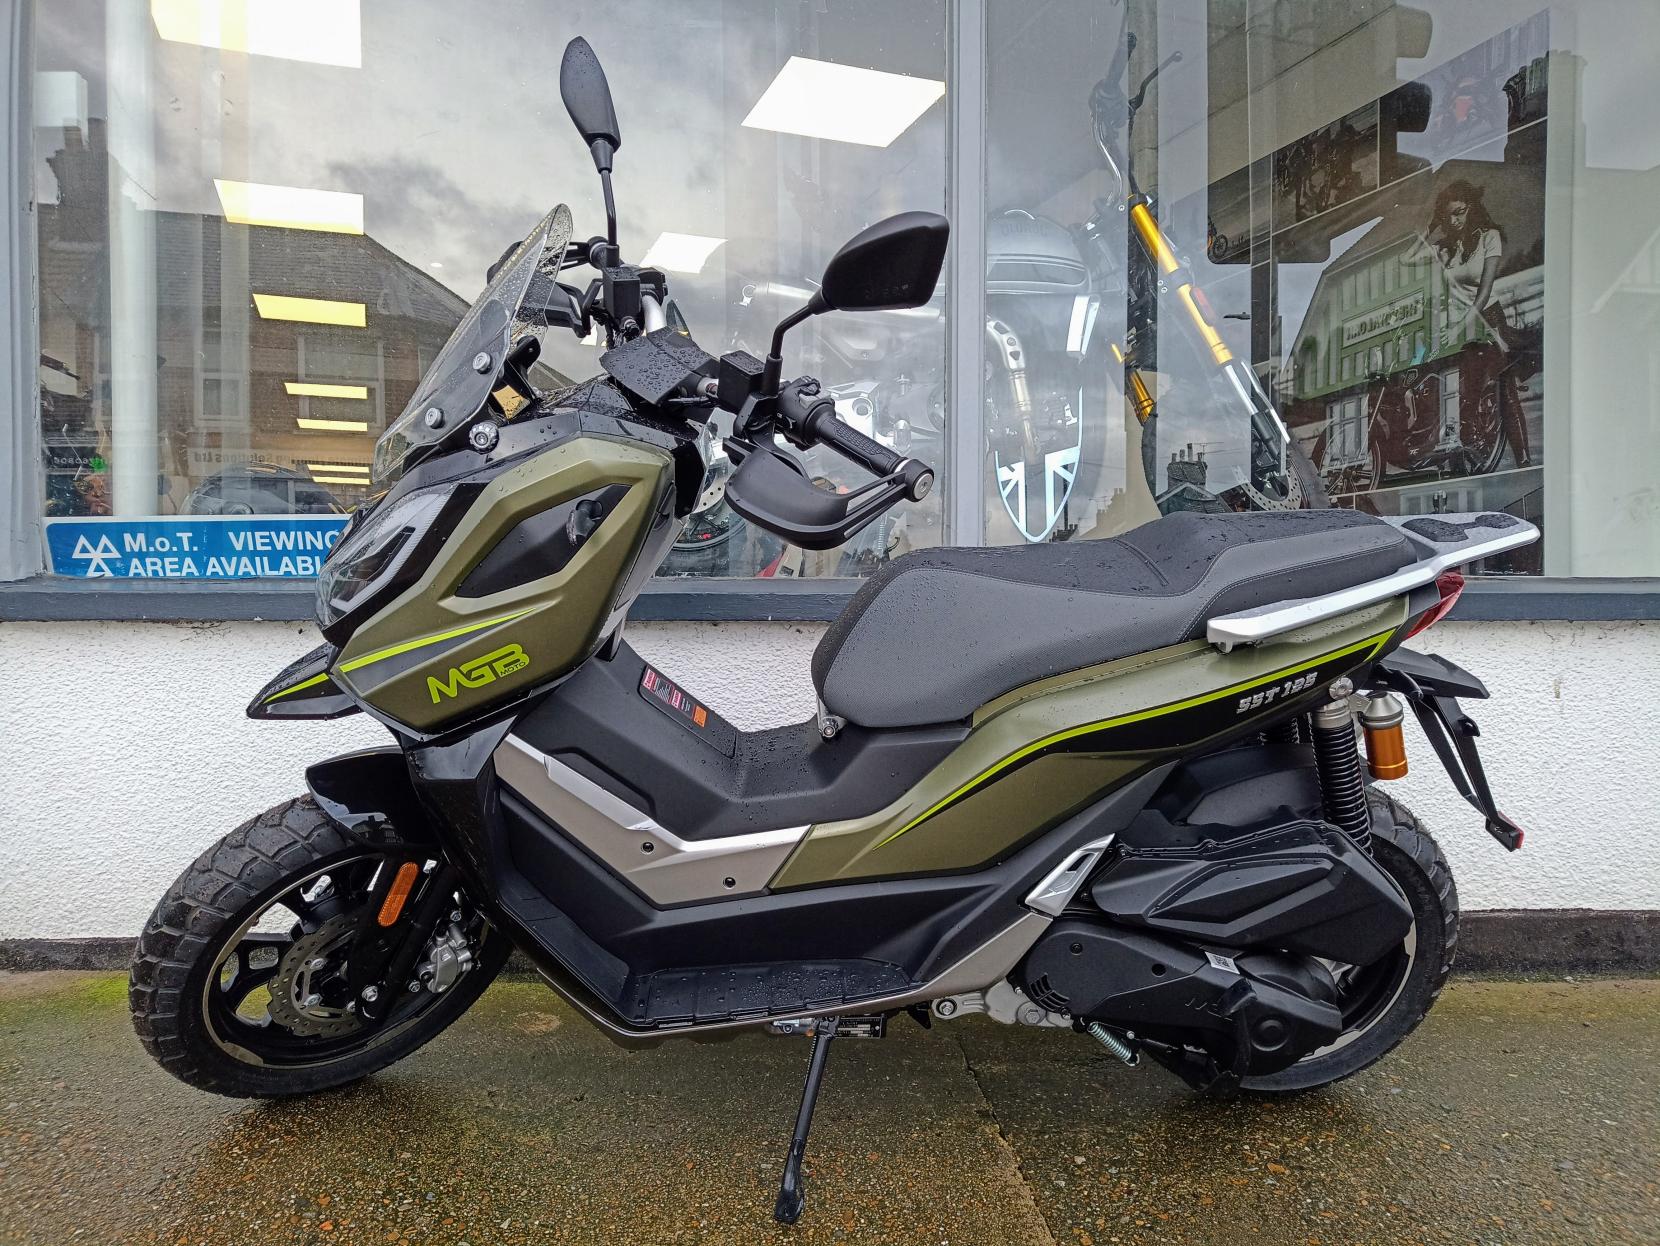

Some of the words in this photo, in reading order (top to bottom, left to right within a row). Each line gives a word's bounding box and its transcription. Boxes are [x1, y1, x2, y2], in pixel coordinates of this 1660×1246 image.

[123, 532, 198, 552] M.o.T.
[128, 556, 200, 577] AREA
[426, 643, 530, 704] MGB
[500, 661, 526, 676] MOTO
[1281, 672, 1318, 698] 125
